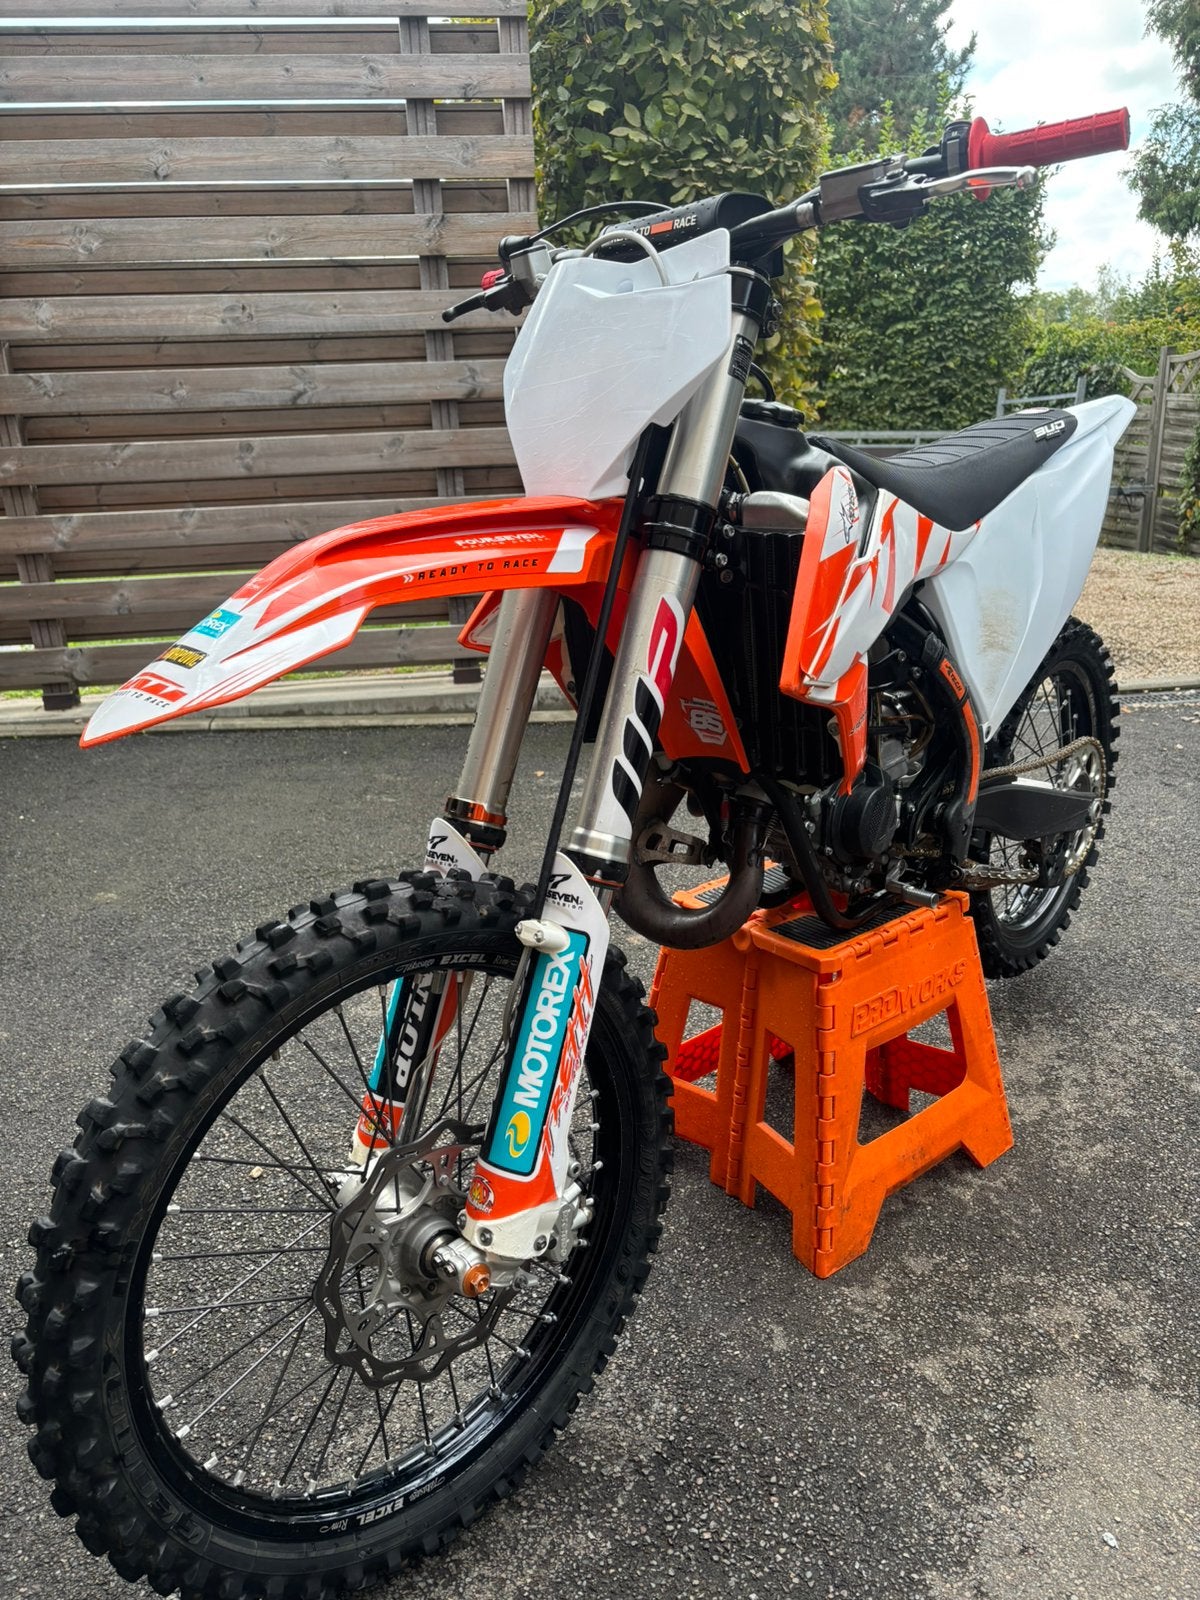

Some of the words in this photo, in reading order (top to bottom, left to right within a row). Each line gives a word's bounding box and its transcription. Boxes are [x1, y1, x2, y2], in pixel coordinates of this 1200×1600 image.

[639, 225, 651, 237] TO
[673, 214, 698, 230] RACE
[418, 565, 468, 580] READY
[478, 562, 494, 572] TO
[503, 558, 539, 569] RACE
[440, 953, 487, 966] EXCEL
[855, 958, 967, 1031] PROWORKS
[513, 950, 575, 1109] MOTOREX
[356, 1497, 405, 1526] EXCEL
